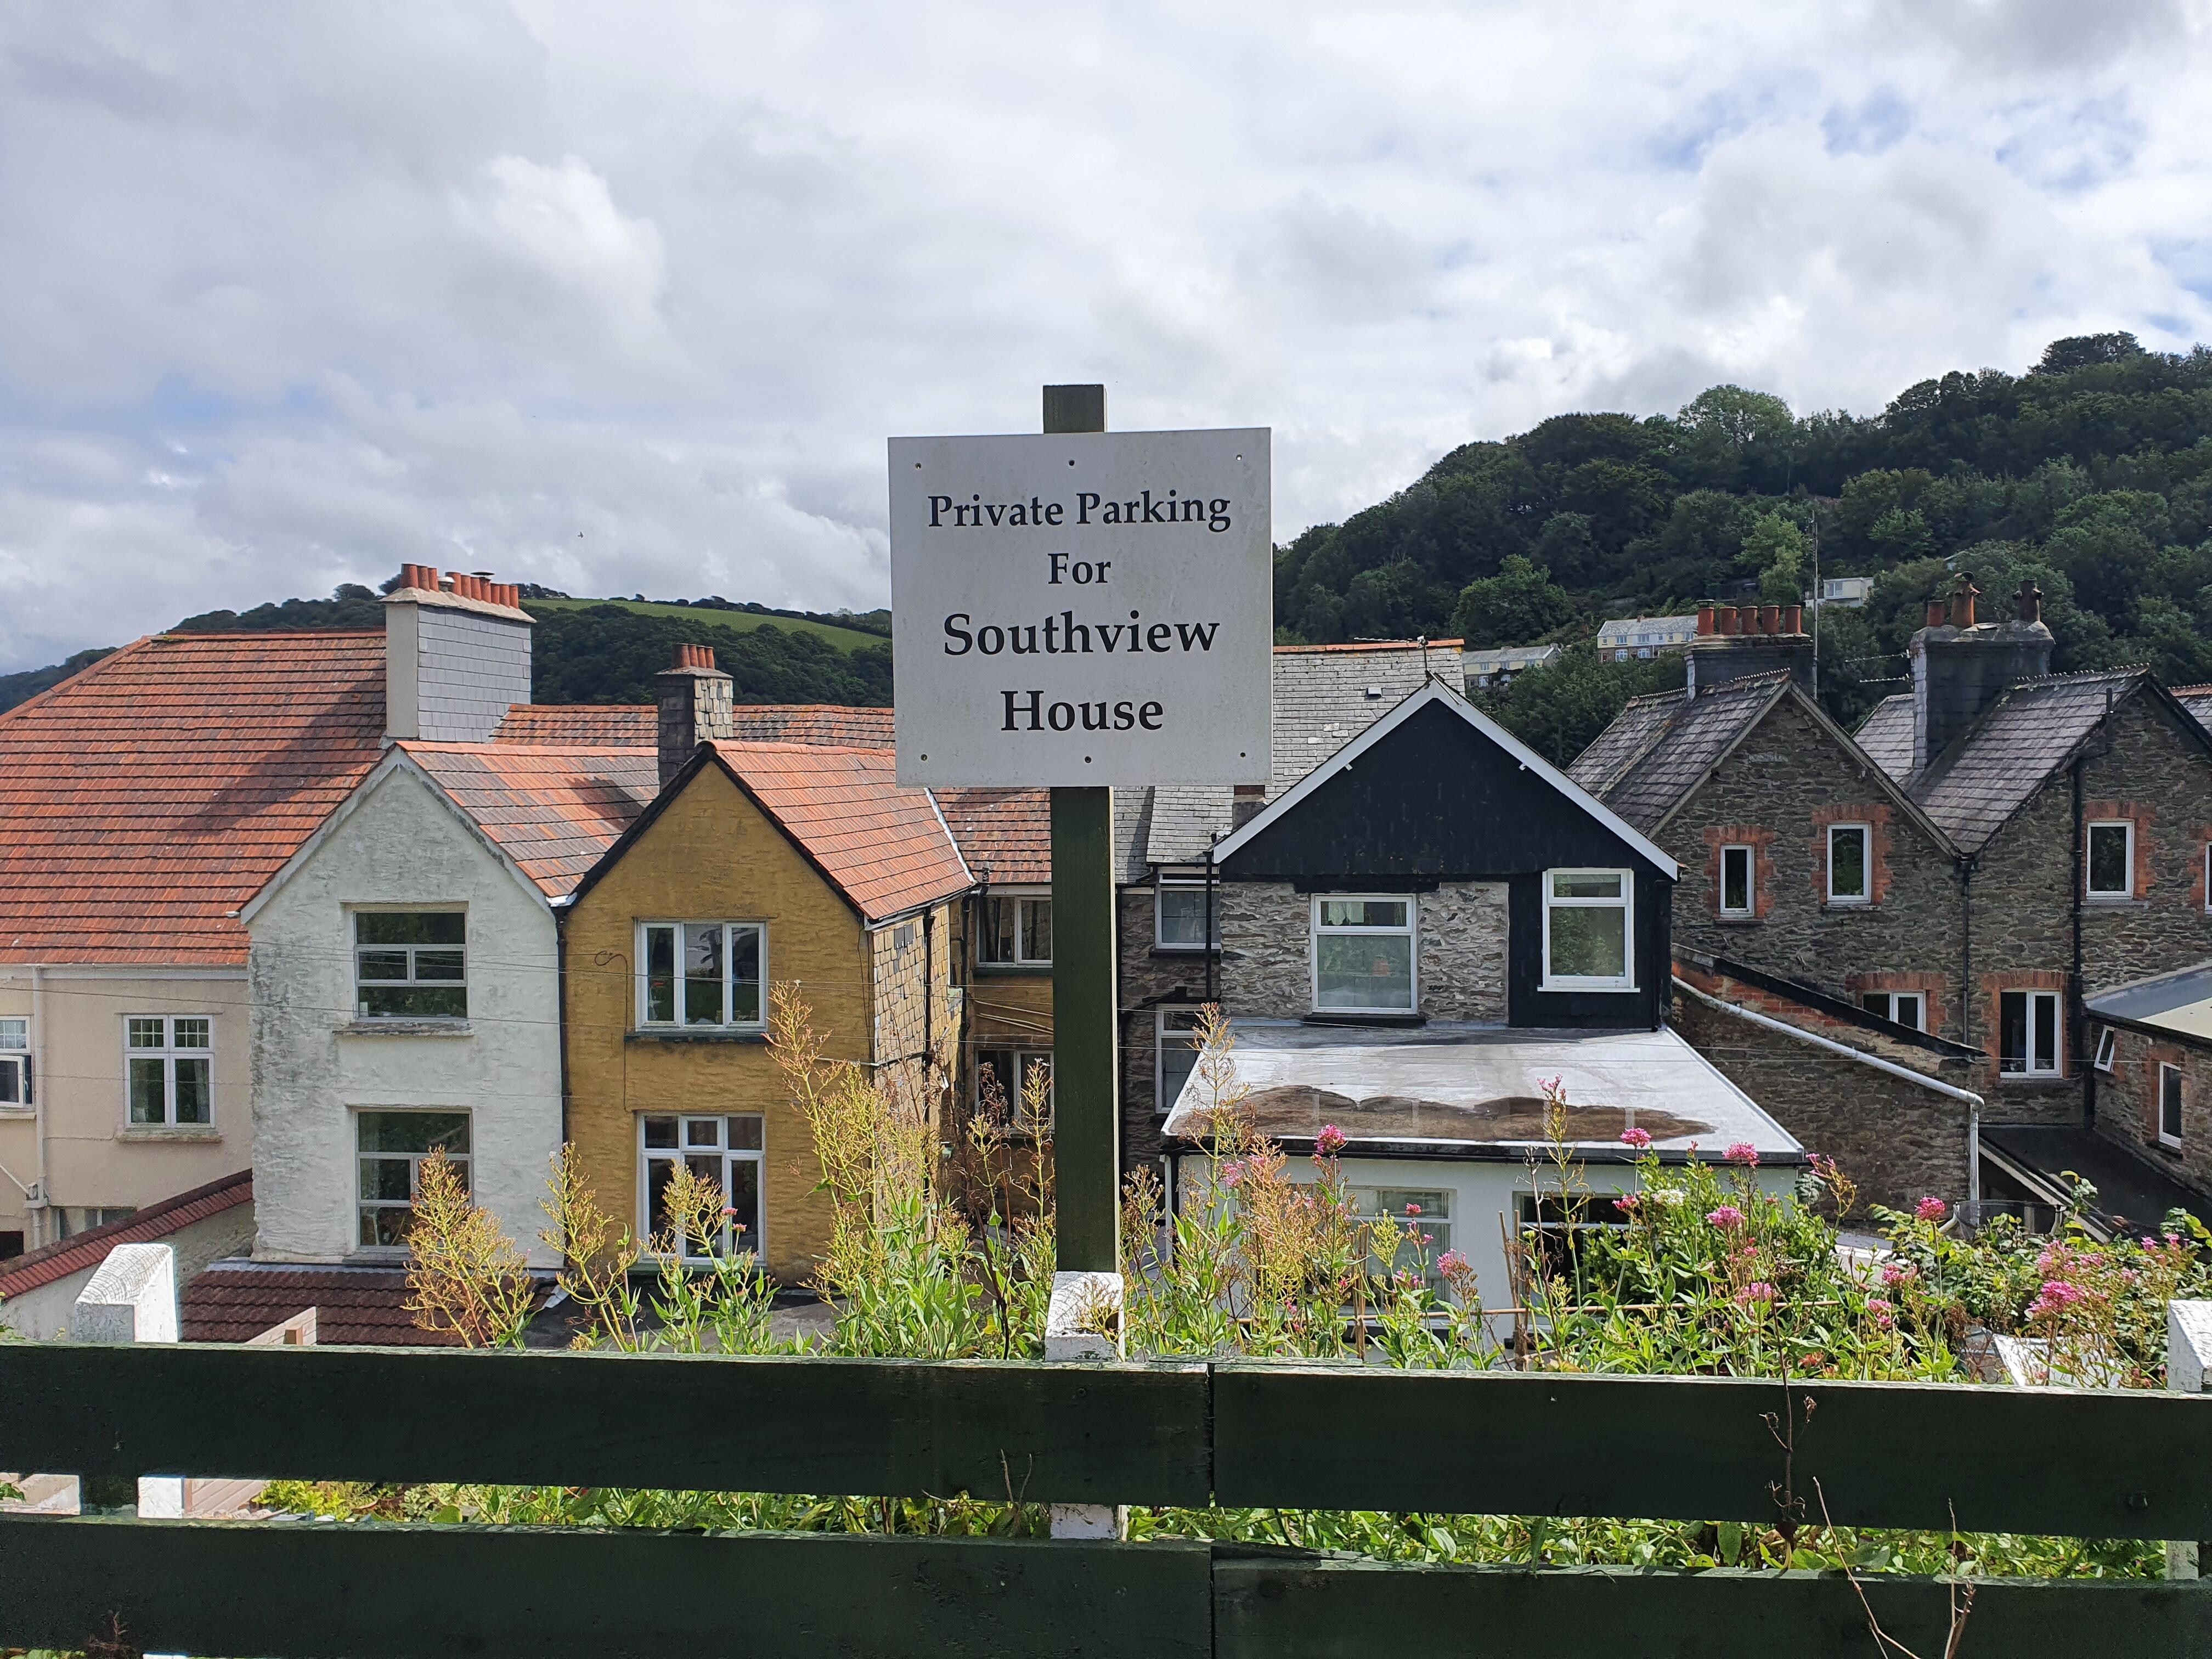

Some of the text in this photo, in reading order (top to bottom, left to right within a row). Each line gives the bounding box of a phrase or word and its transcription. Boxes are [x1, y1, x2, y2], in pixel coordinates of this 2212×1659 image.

[928, 490, 1231, 532] Private Parking
[1048, 553, 1111, 584] For
[944, 610, 1220, 655] Southview
[1001, 691, 1163, 731] House
